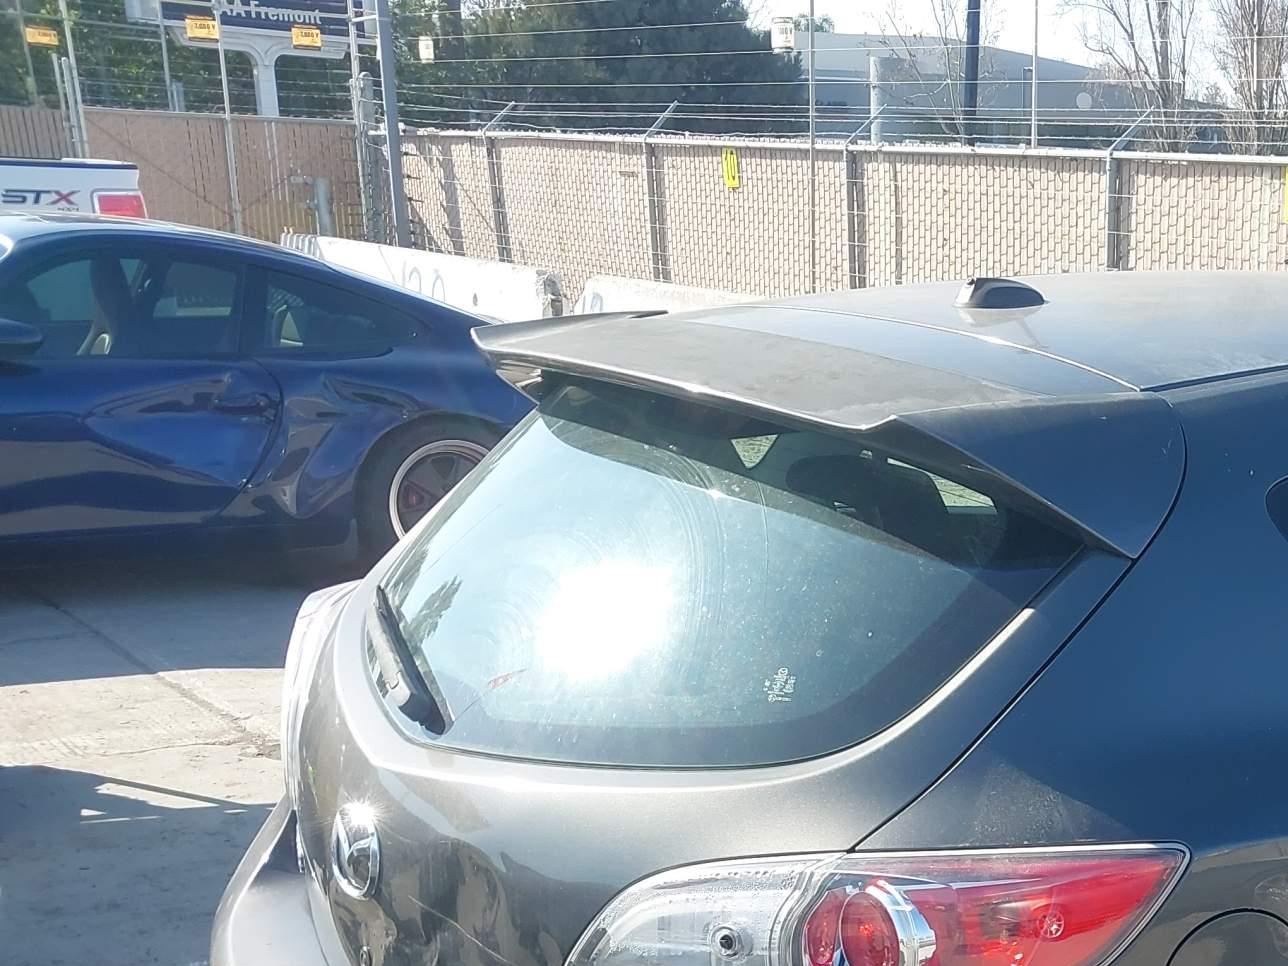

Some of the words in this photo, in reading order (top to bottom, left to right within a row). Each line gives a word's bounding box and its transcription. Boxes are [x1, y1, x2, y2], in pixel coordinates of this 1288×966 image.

[213, 0, 246, 17] AA
[250, 1, 322, 24] Fremont
[1, 190, 80, 205] STX
